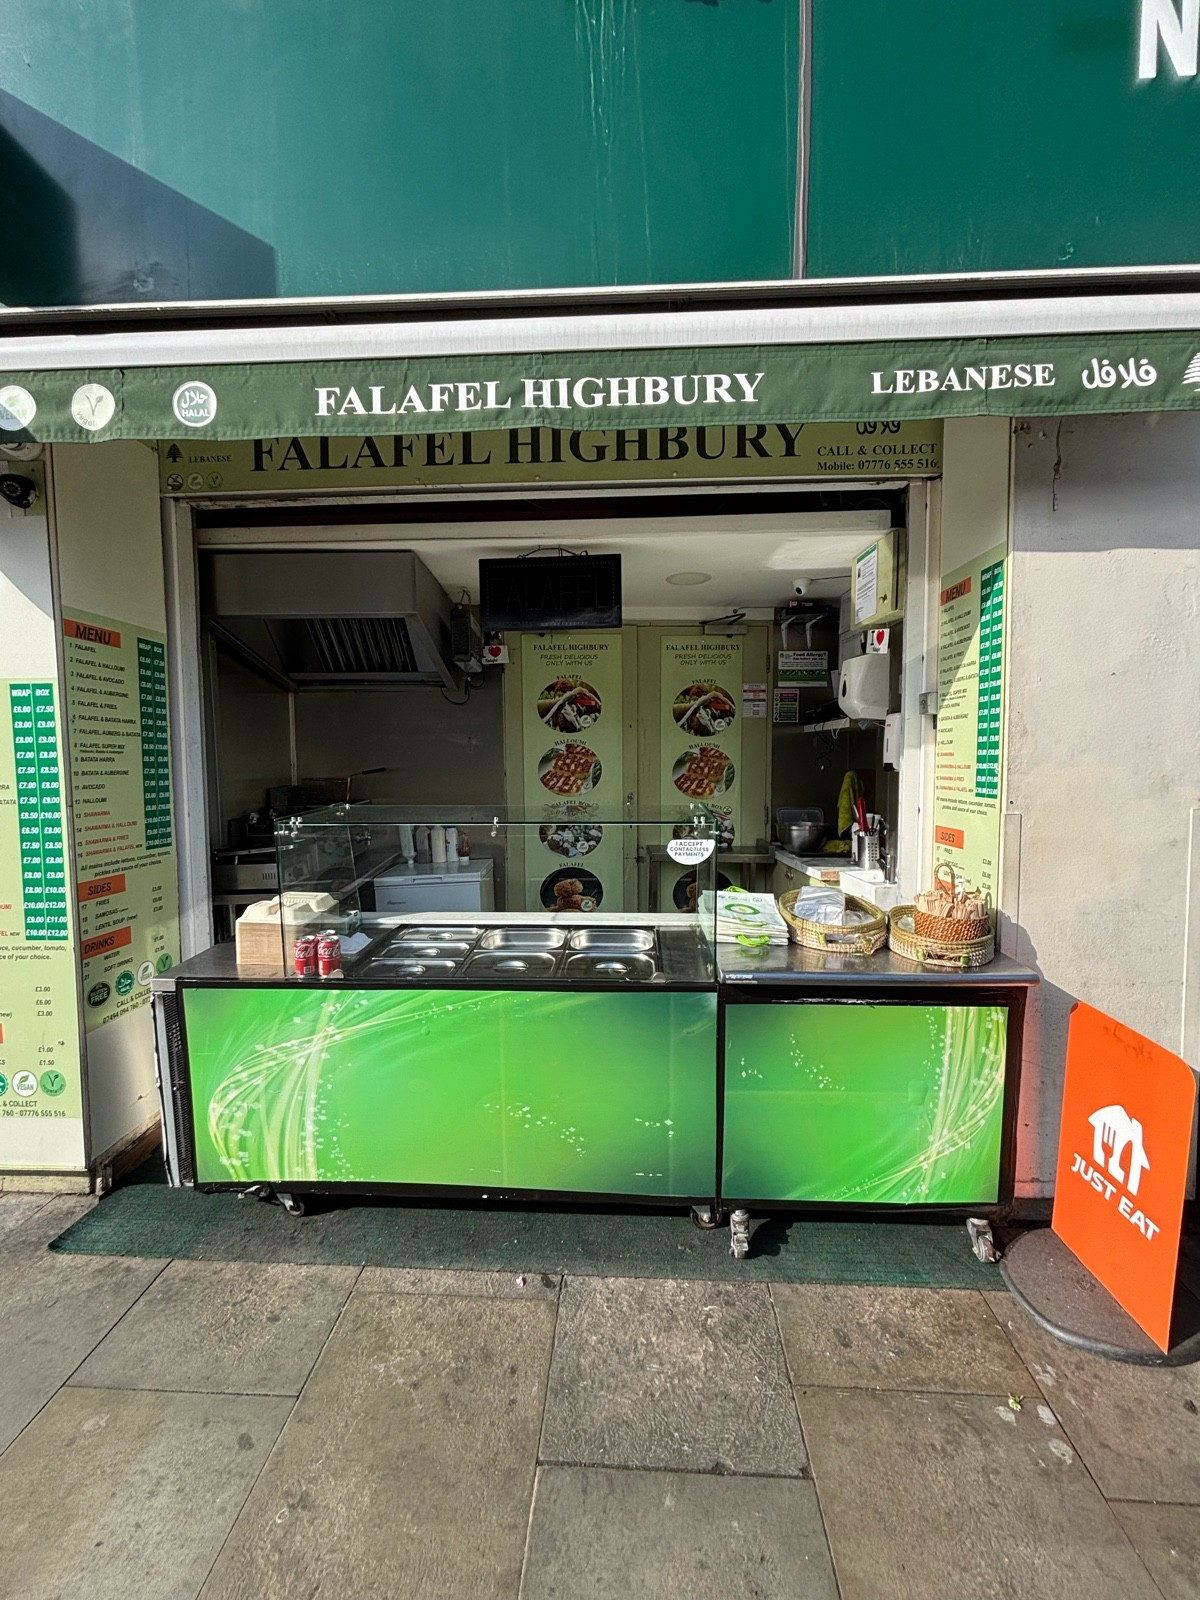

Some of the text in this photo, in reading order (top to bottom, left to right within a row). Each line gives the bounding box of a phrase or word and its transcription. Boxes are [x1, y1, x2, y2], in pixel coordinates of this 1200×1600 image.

[1139, 0, 1199, 79] N
[871, 363, 1056, 395] LEBANESE
[1082, 358, 1157, 390] فلافل
[181, 390, 208, 408] حلال
[314, 372, 766, 416] FALAFEL HIGHBURY
[182, 408, 210, 418] HALAL
[250, 423, 806, 472] FALAFEL HIGHBURY
[818, 444, 937, 457] CALL & COLLECT
[189, 455, 232, 464] LEBANESE
[818, 461, 854, 471] Mobile:
[858, 460, 892, 470] 07776
[894, 459, 914, 470] 555
[946, 581, 966, 602] MENU
[75, 624, 112, 645] MENU
[75, 644, 96, 653] FALAFEL
[76, 658, 125, 672] FALAFEL HALLOUMI
[76, 672, 125, 685] FALAFEL AVOCADO
[77, 687, 98, 695] FALAFEL
[689, 742, 720, 750] HALLOUMI
[941, 831, 955, 843] SIDES
[88, 882, 112, 896] SIDES
[95, 908, 119, 920] SAMOSAS
[95, 917, 125, 931] LENTIL SOUP
[84, 936, 115, 954] DRINKS
[104, 951, 120, 960] WATER
[104, 957, 134, 972] SOFT DRINKS
[90, 992, 108, 1004] FREE
[117, 998, 129, 1008] CALL
[103, 1002, 138, 1024] 07494 094 760
[1070, 1152, 1160, 1241] JUST EAT
